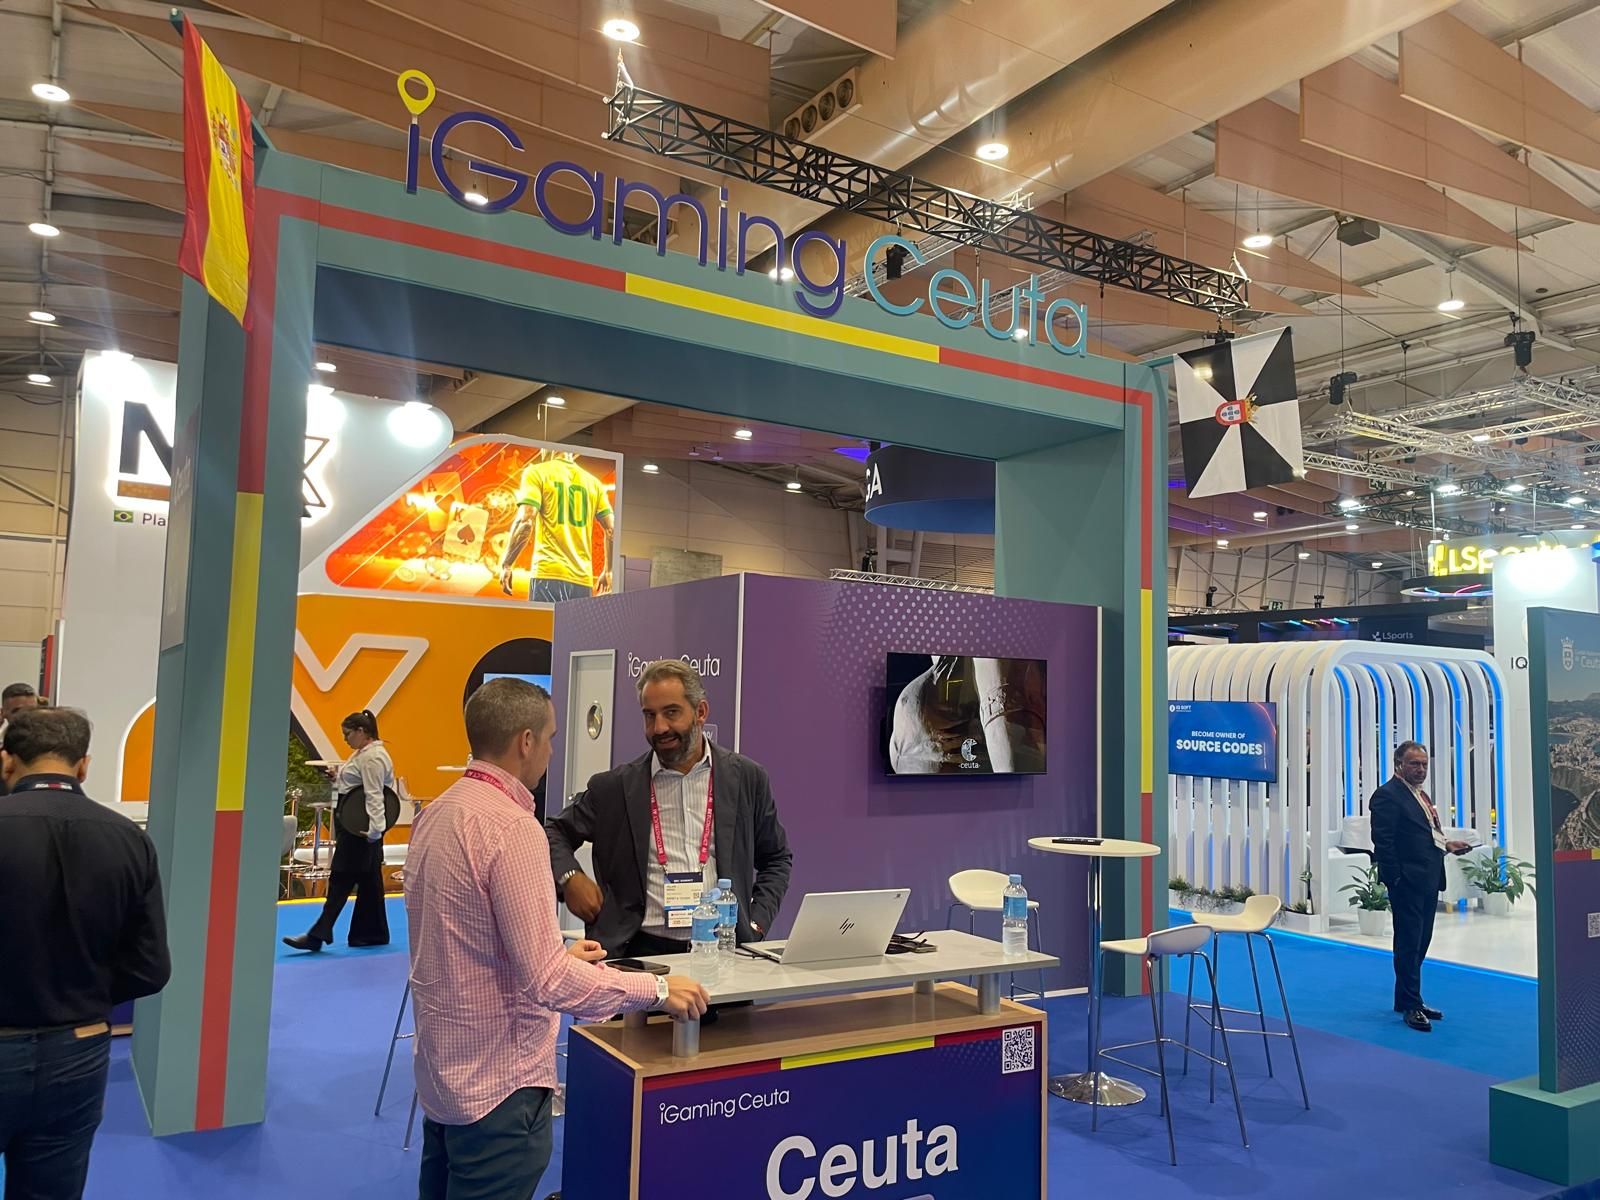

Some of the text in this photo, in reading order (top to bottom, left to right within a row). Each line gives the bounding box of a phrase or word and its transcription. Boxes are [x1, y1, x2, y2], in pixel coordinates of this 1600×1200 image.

[397, 70, 1088, 357] iGaming Ceuta
[554, 481, 587, 528] 10
[142, 513, 167, 527] Pla
[1511, 656, 1528, 670] IQ
[1176, 739, 1262, 755] SOURCE CODES
[1191, 730, 1214, 738] BECOME
[1215, 731, 1236, 739] OWNER
[660, 1088, 790, 1124] iGaming Ceuta
[766, 1118, 959, 1200] Ceuta
